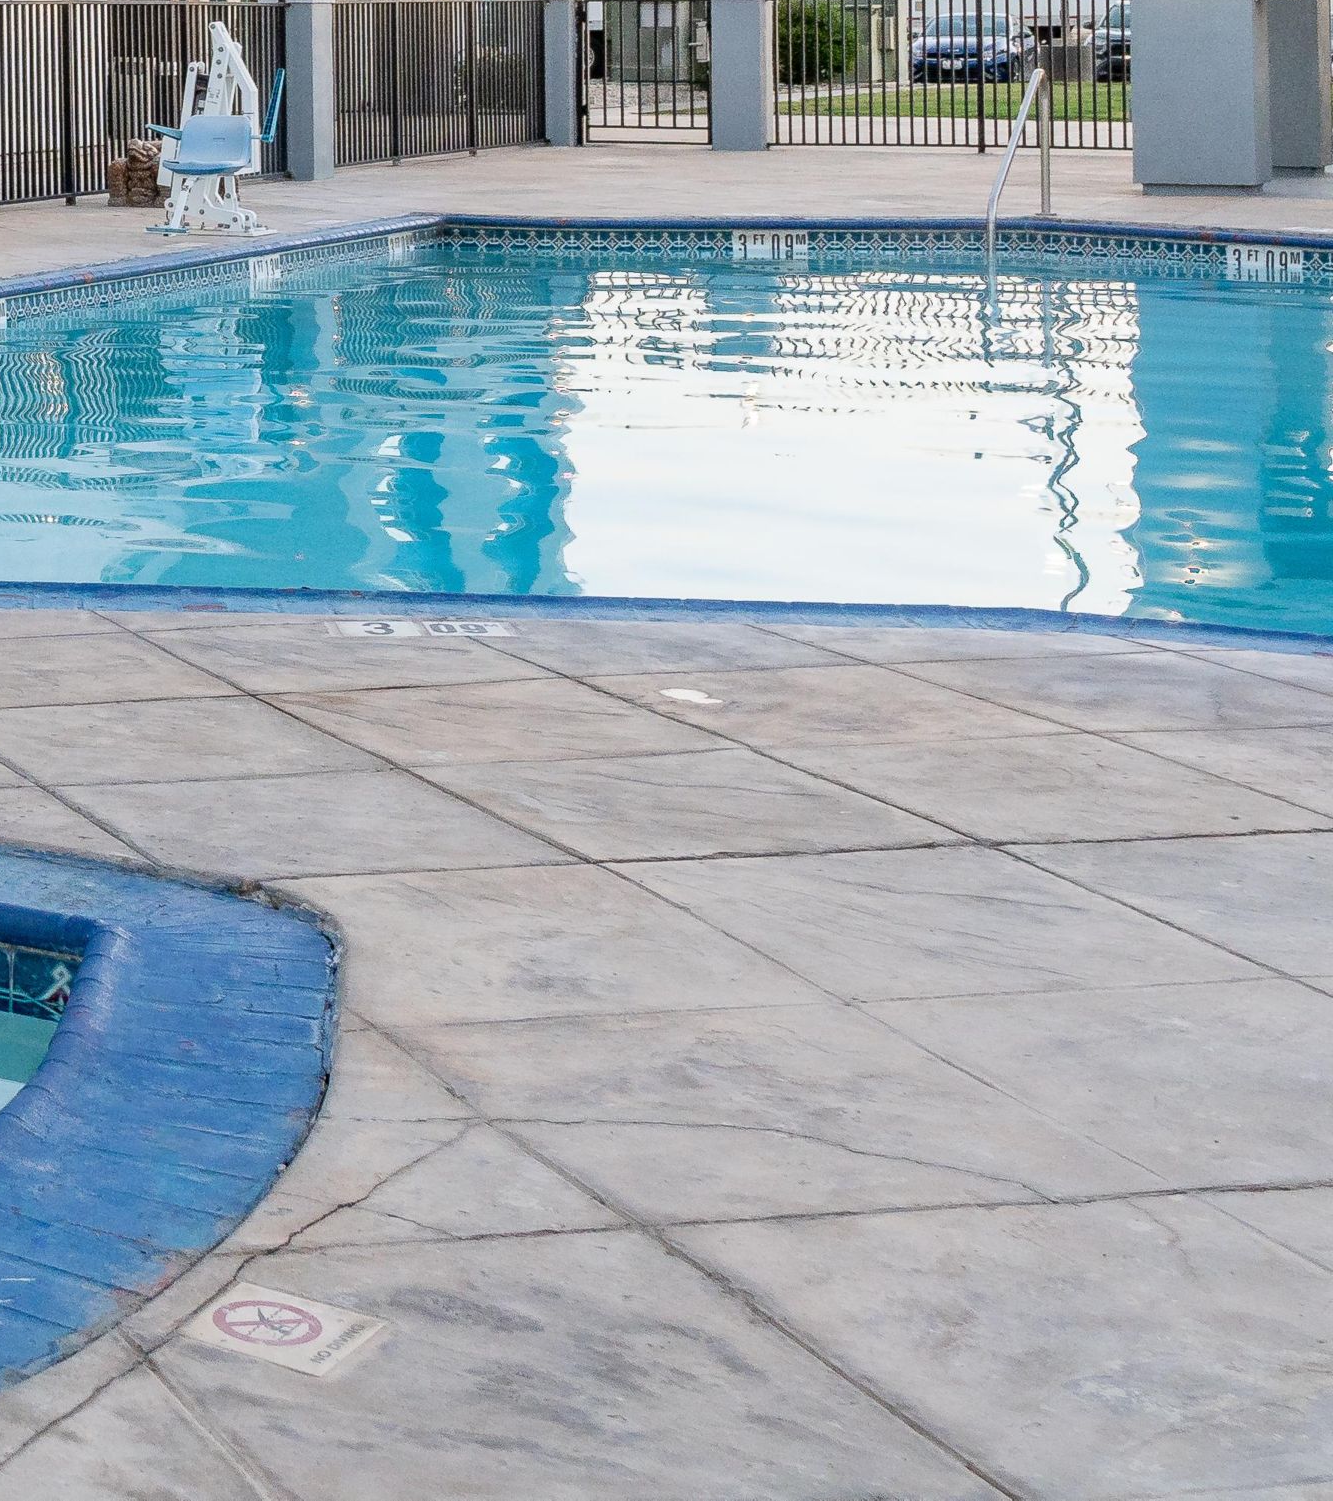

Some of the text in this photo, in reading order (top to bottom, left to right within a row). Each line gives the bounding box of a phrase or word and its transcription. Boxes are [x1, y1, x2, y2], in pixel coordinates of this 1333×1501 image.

[753, 234, 765, 245] FT
[1233, 249, 1241, 269] 3
[1248, 250, 1260, 262] FT
[362, 622, 395, 635] 3
[309, 1323, 365, 1365] NO DIVING
